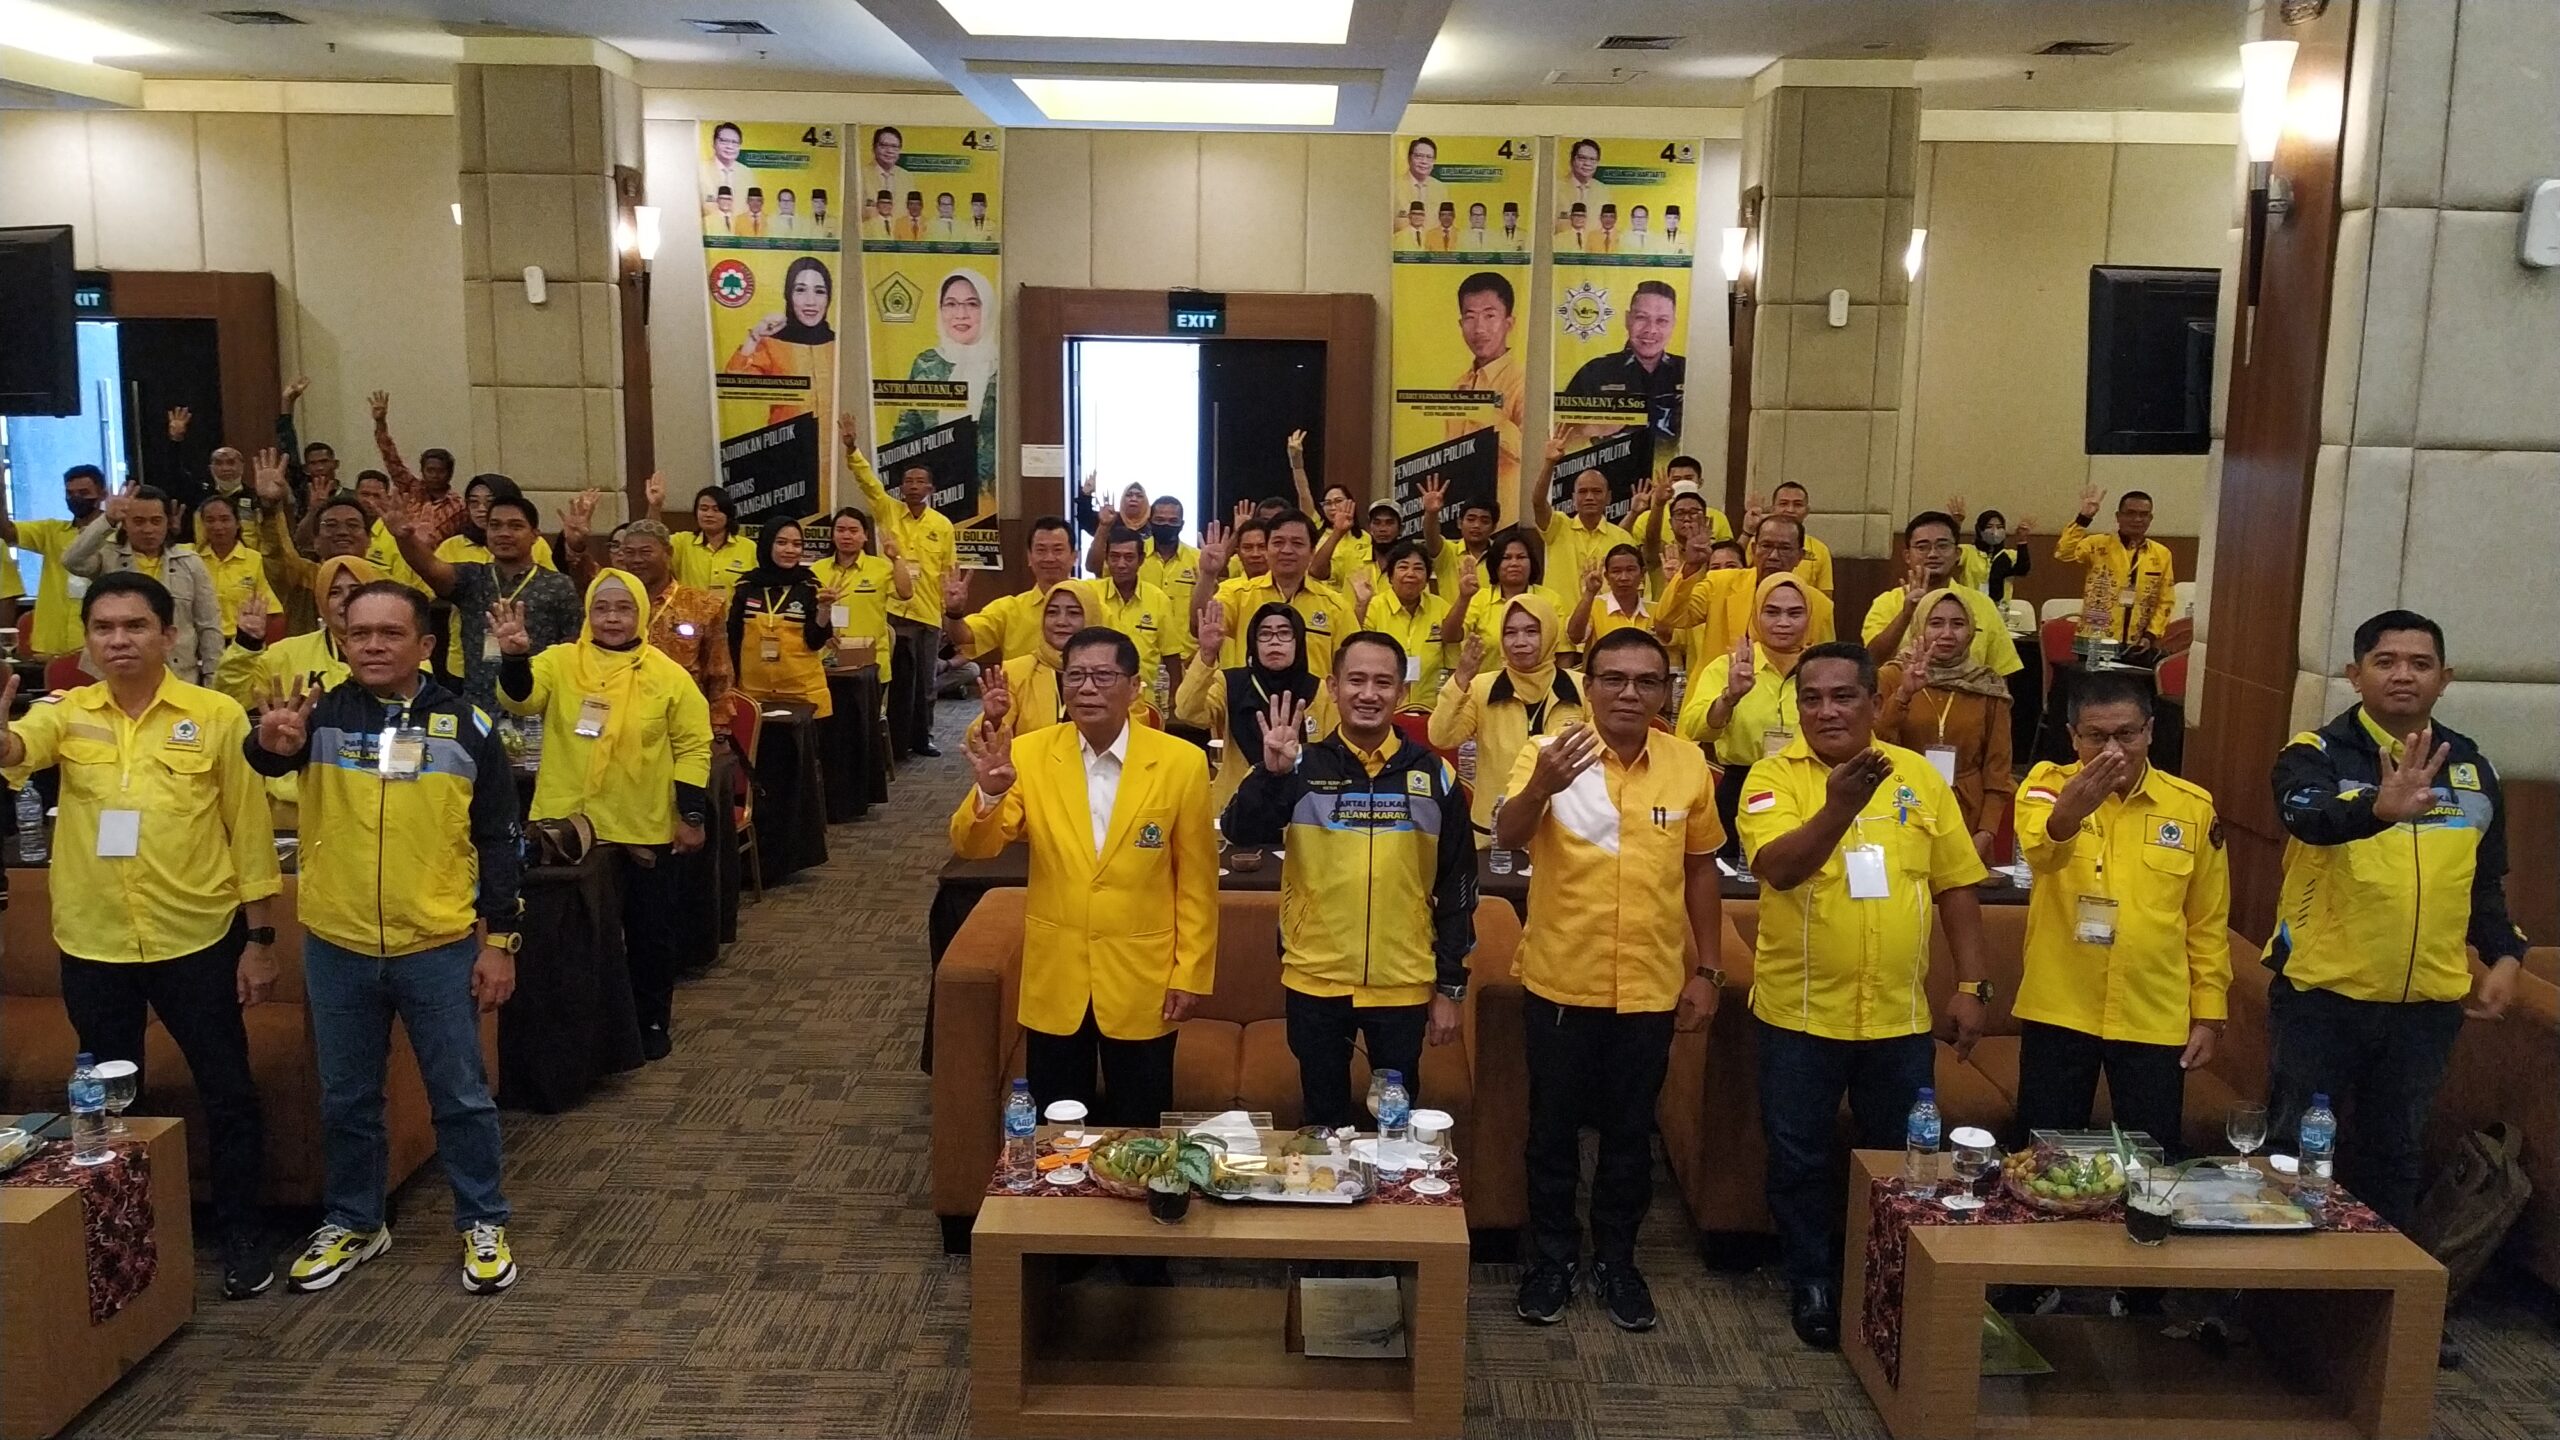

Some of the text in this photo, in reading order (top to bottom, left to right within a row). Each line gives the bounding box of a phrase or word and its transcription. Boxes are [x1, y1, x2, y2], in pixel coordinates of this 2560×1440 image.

[802, 127, 819, 146] 4
[962, 130, 978, 149] 4
[1498, 140, 1513, 160] 4
[1660, 143, 1676, 162] 4
[75, 293, 100, 306] XIT
[1177, 314, 1216, 328] EXIT
[954, 385, 967, 395] SP
[721, 424, 796, 463] NDIDIKAN POLITIK
[878, 427, 955, 468] ENDIDIKAN POLITIK
[1394, 438, 1476, 479] PENDIDIKAN POLITIK
[1552, 440, 1632, 481] ENDIDIKAN POLITIK
[773, 480, 806, 505] PEMILU
[932, 483, 965, 509] PEMILU
